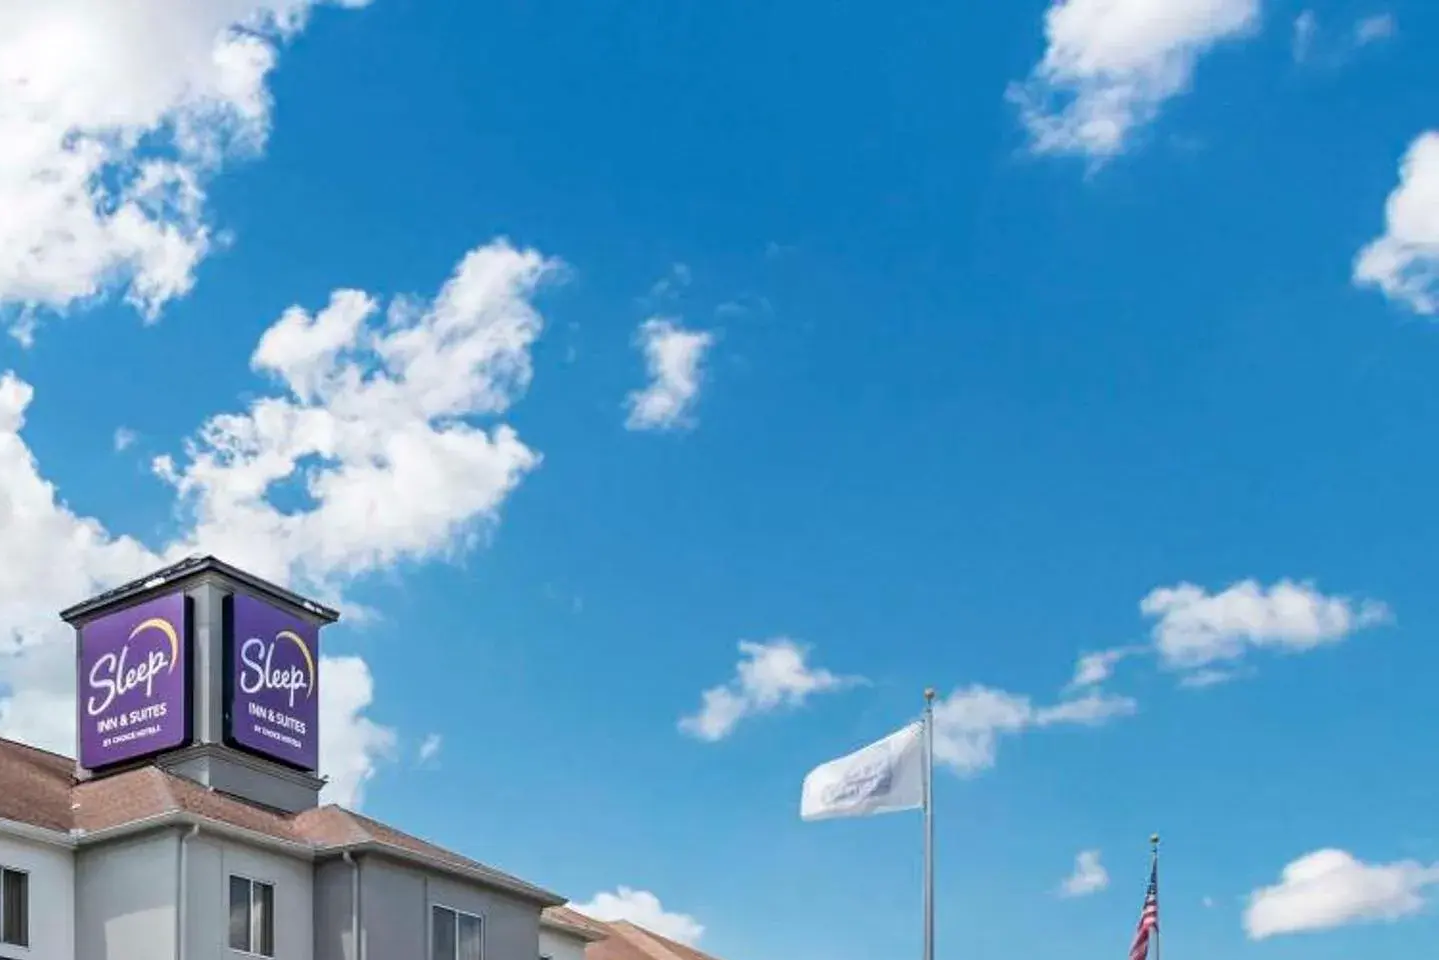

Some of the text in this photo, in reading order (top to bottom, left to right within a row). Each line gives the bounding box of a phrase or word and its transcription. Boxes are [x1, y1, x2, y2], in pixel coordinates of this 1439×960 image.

[87, 646, 169, 716] Sleep
[239, 638, 308, 707] Sleep
[97, 702, 168, 733] INN & SUITES
[249, 702, 307, 735] INN & SUITES
